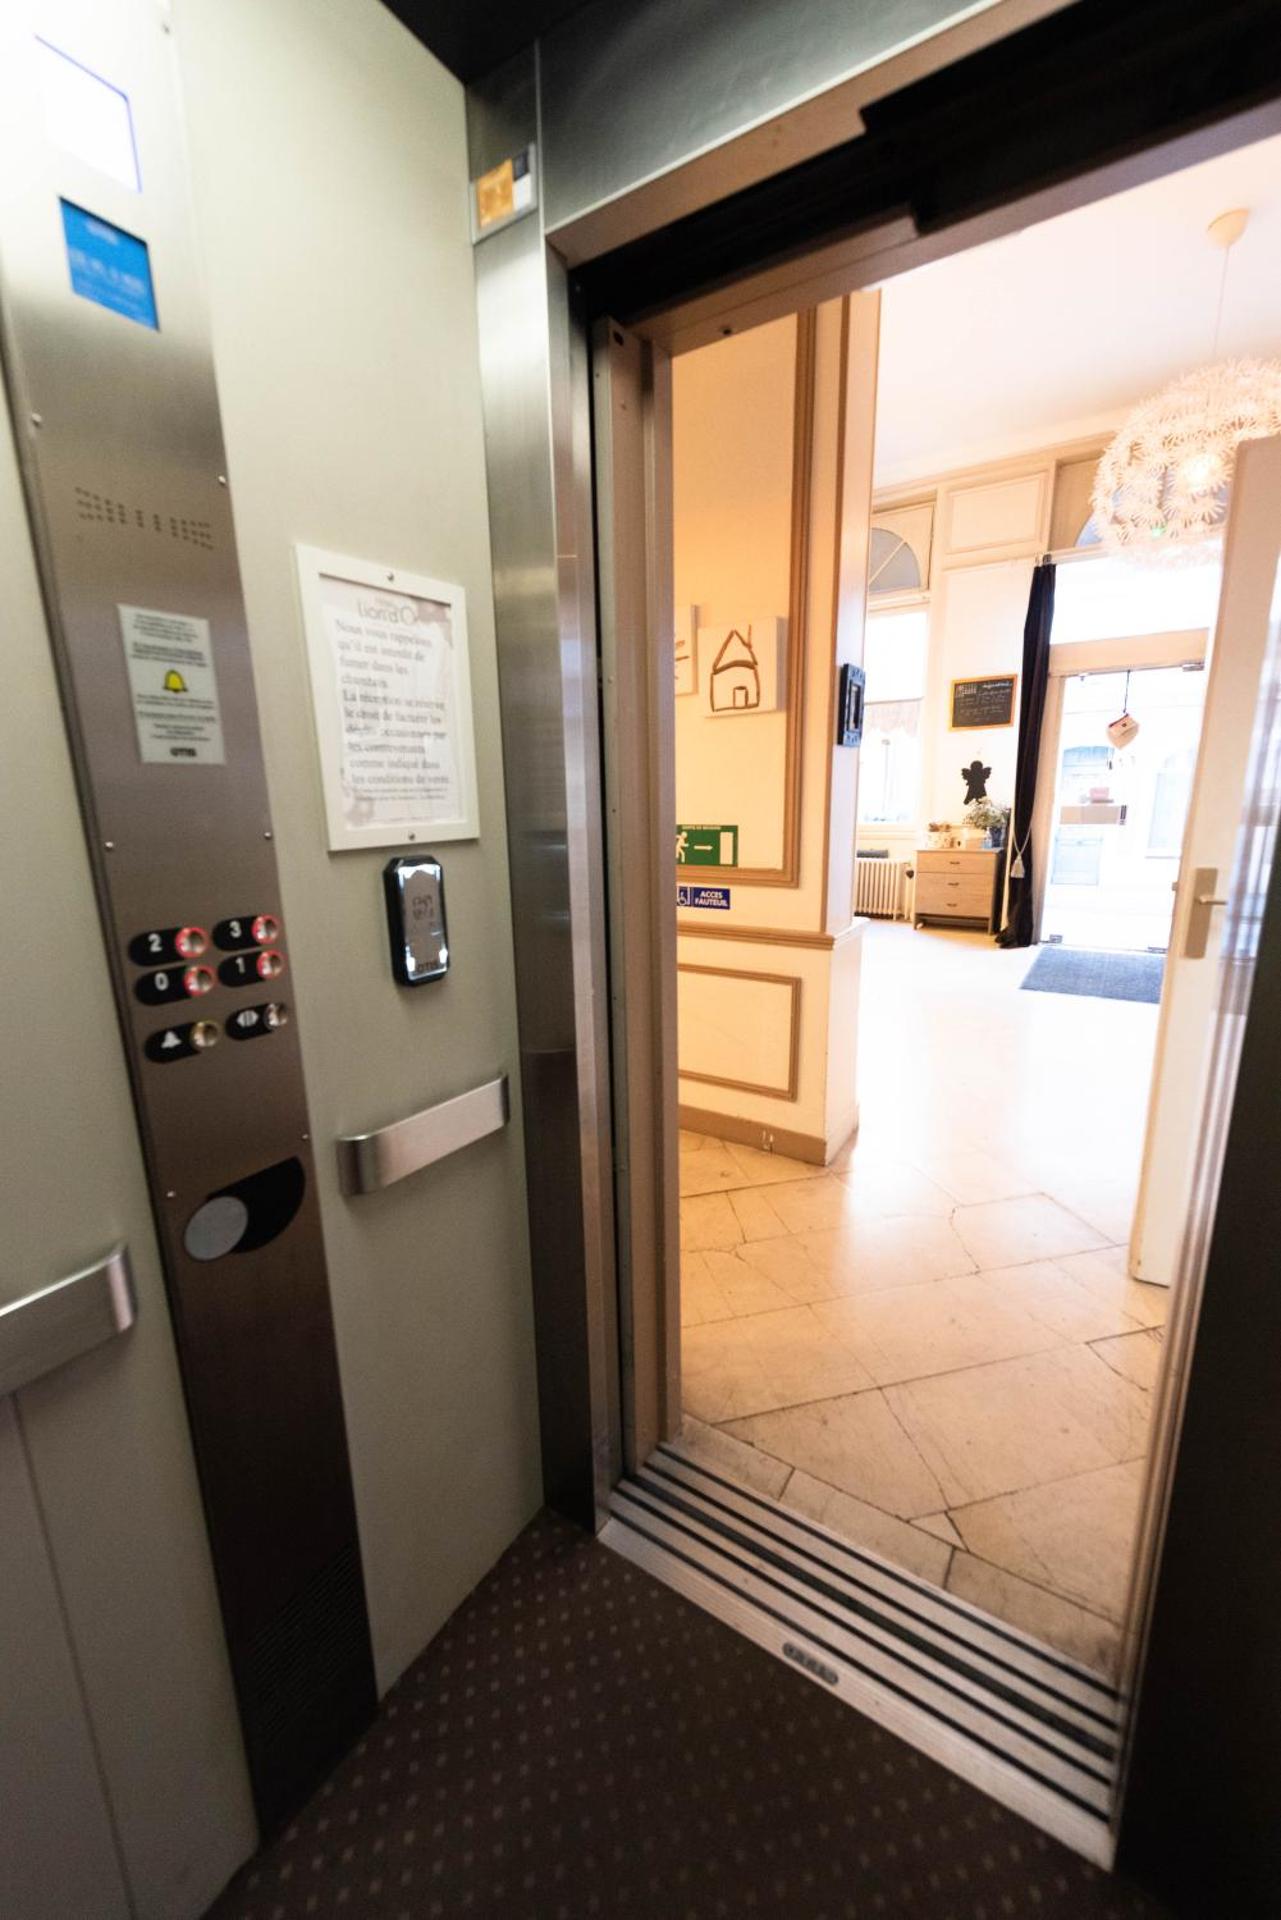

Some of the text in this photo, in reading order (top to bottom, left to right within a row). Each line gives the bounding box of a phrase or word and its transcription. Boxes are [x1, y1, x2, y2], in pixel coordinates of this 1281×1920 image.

[229, 920, 242, 938] 3
[148, 933, 162, 953] 2
[235, 957, 246, 974] 1
[154, 972, 169, 991] 0
